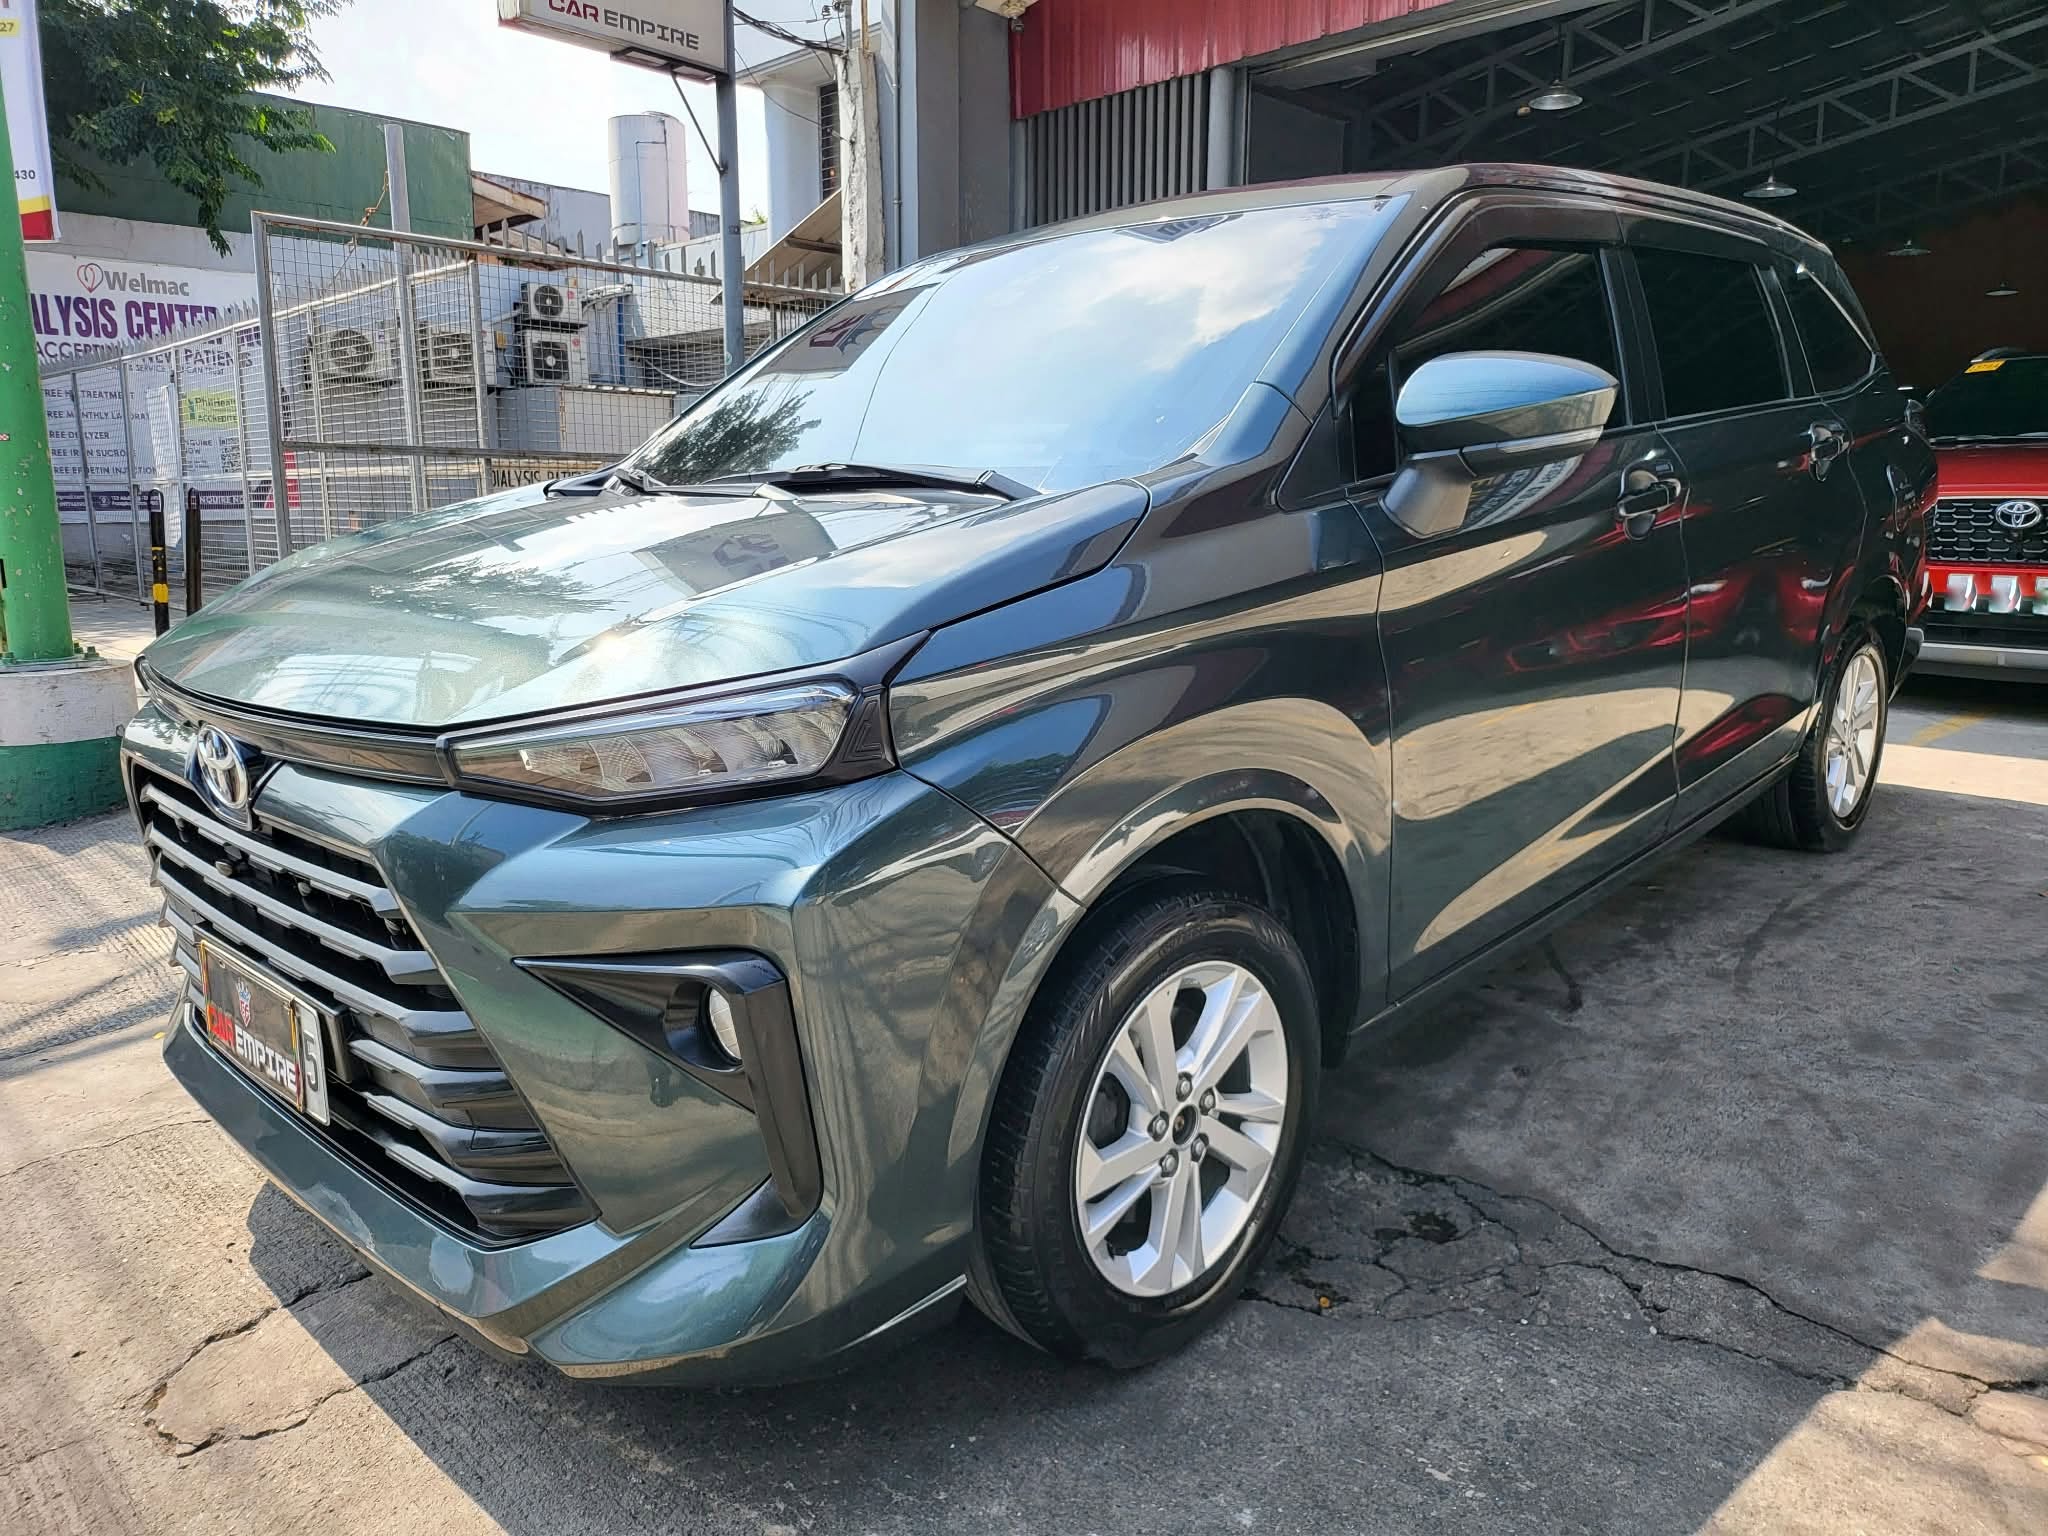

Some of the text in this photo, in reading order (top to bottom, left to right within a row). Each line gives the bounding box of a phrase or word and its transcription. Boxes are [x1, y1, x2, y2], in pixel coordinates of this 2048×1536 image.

[549, 0, 699, 50] CAR EMPIRE
[104, 271, 190, 296] Welmac
[184, 348, 252, 367] PATIENS
[80, 390, 135, 399] TREATMET
[66, 411, 109, 420] MNTHLY
[68, 431, 110, 440] DILYZER
[235, 1023, 298, 1094] EMPIRE
